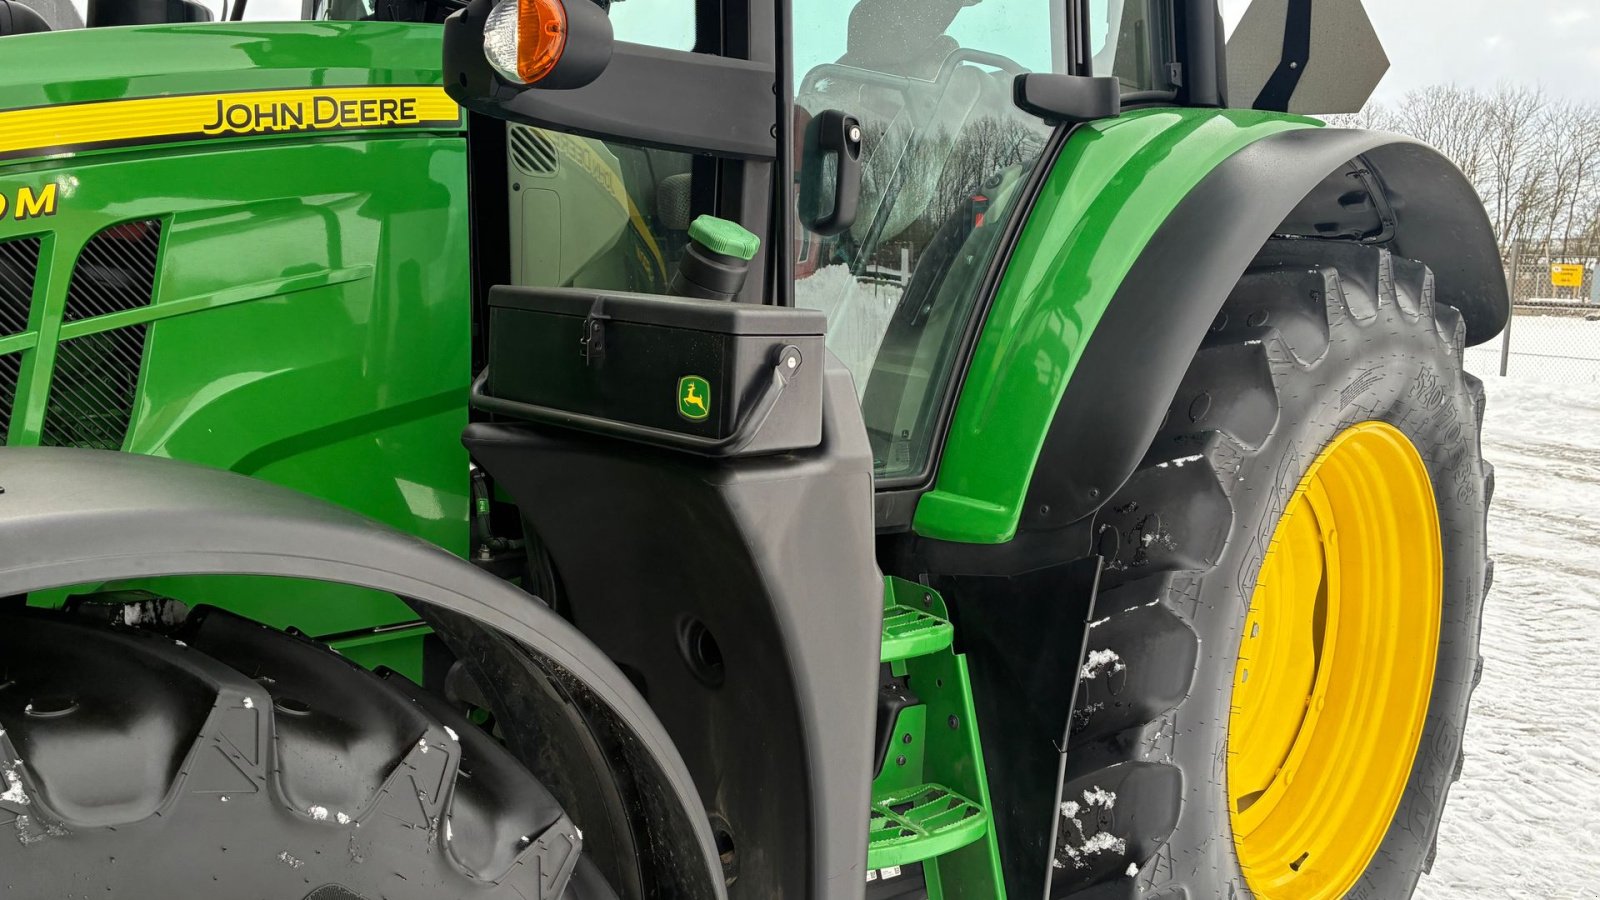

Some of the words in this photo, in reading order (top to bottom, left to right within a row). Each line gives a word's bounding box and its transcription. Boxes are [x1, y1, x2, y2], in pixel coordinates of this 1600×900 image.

[203, 99, 304, 131] JOHN
[312, 95, 417, 125] DEERE
[0, 183, 59, 221] M
